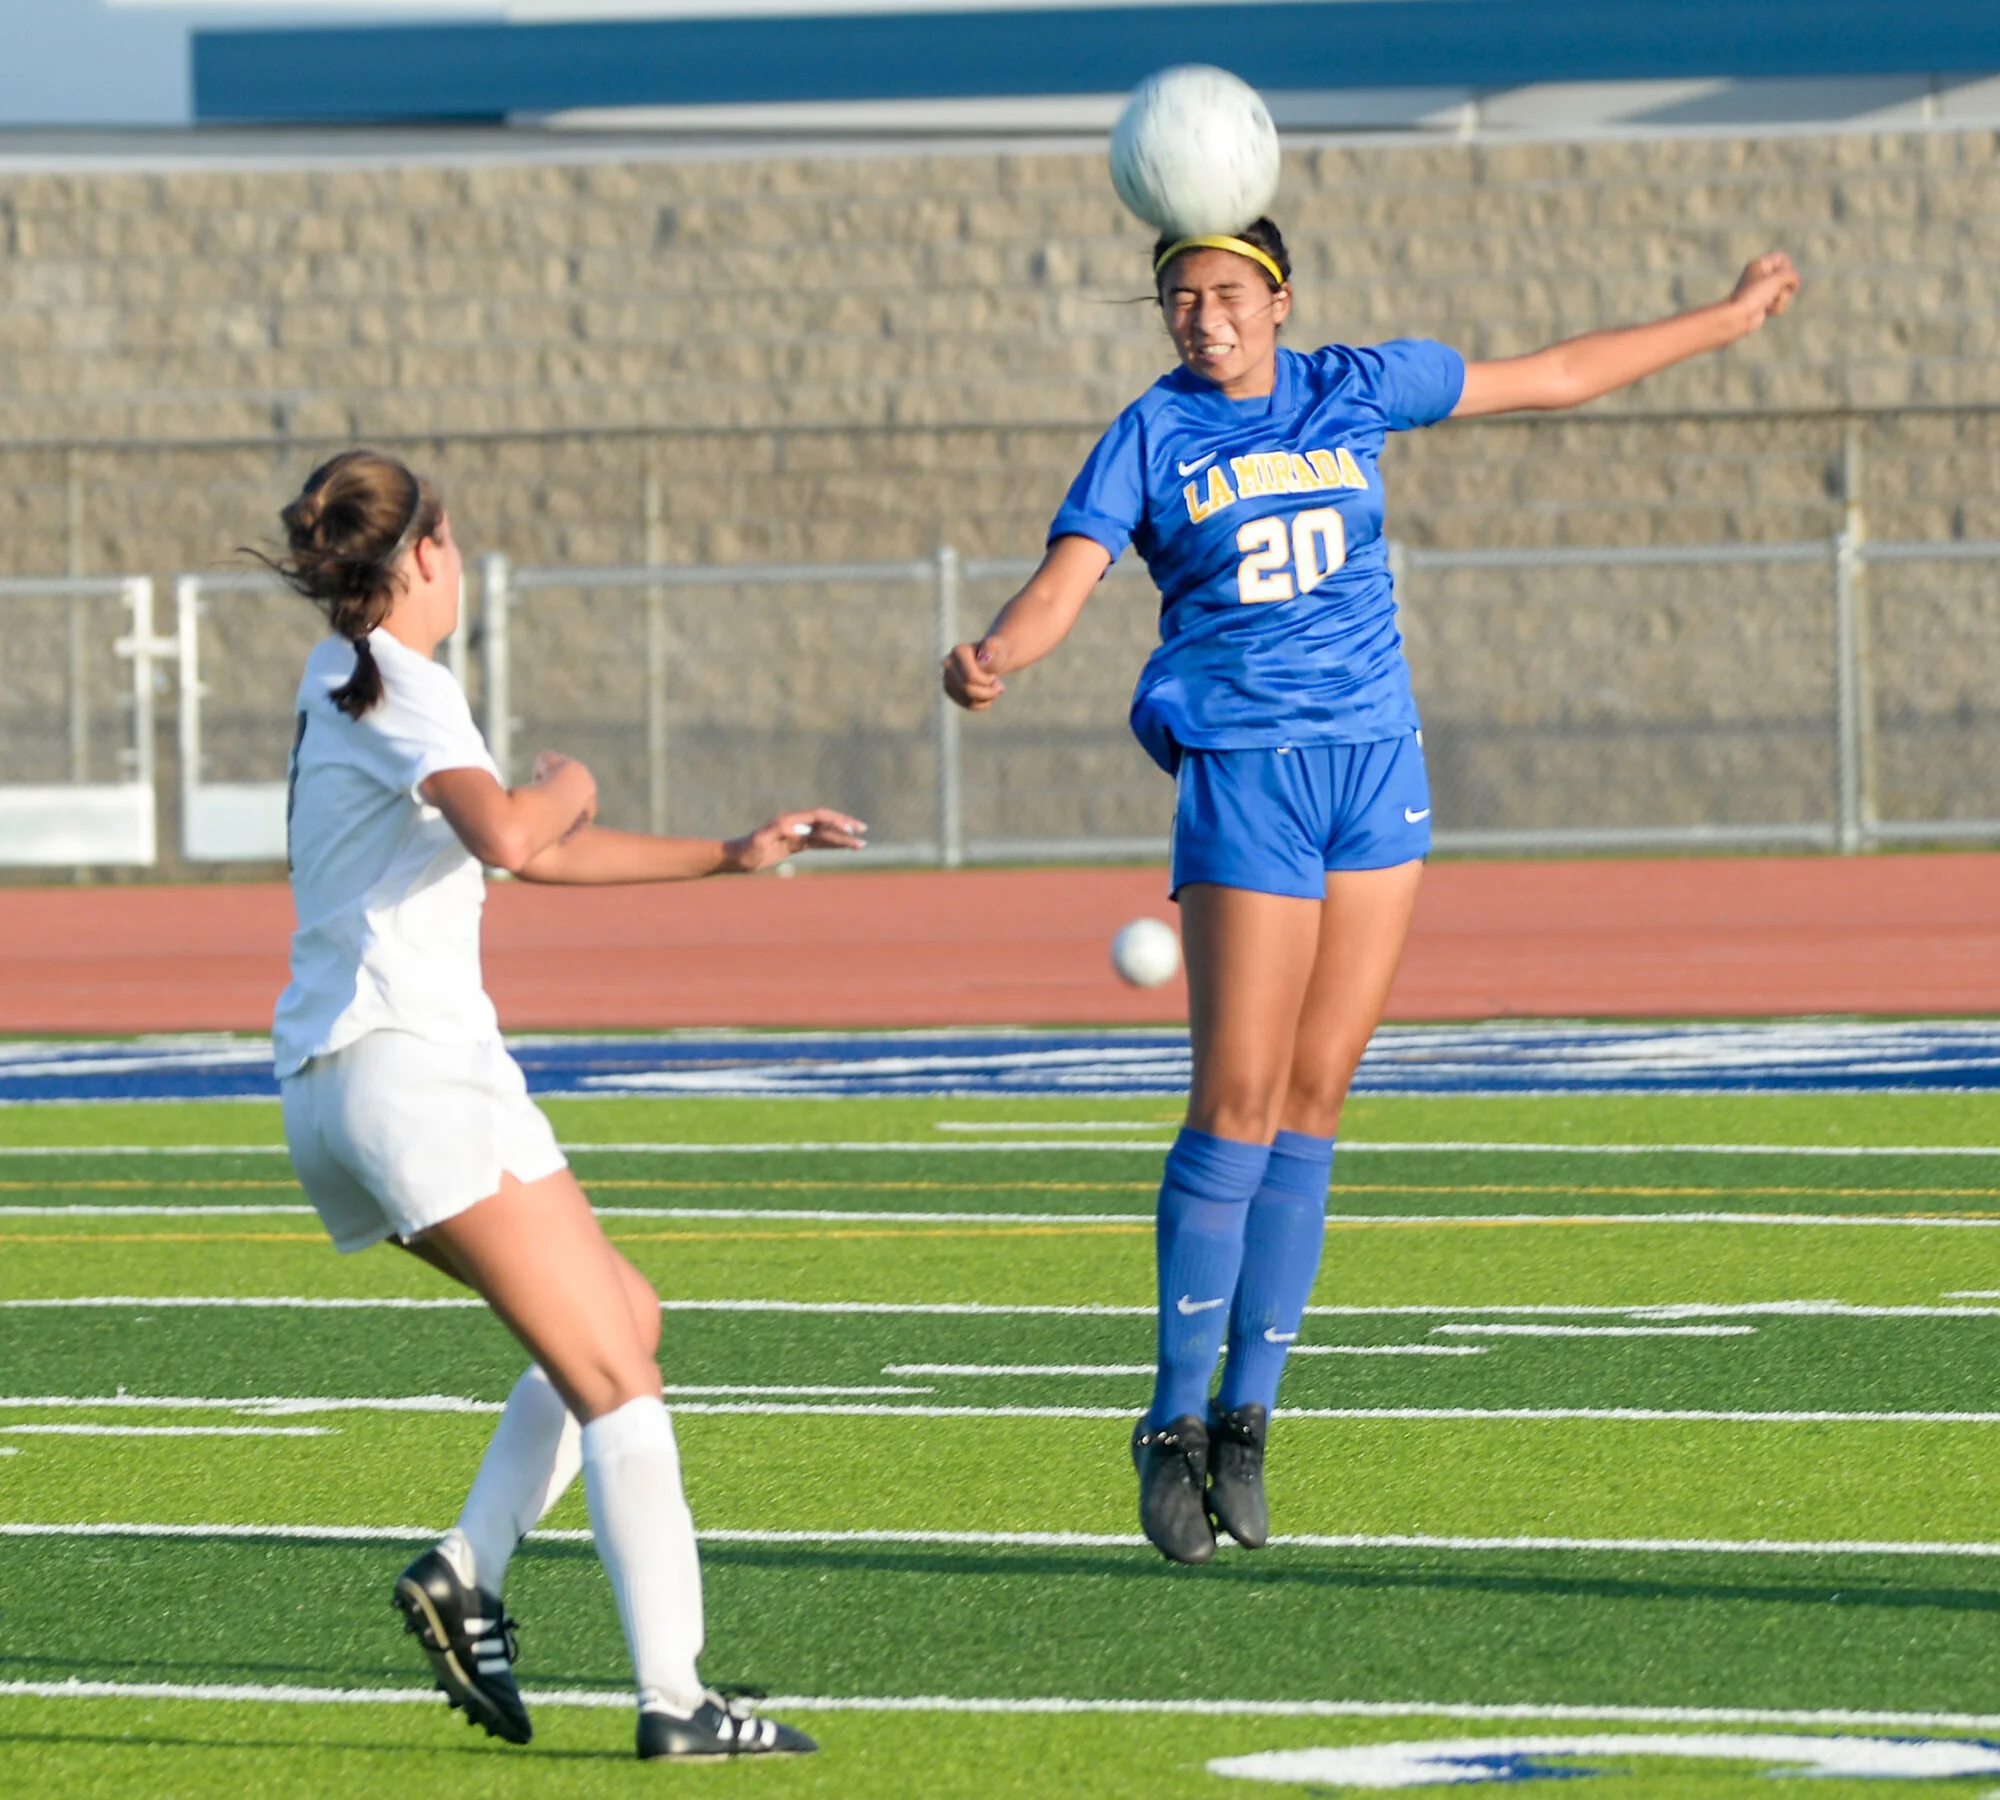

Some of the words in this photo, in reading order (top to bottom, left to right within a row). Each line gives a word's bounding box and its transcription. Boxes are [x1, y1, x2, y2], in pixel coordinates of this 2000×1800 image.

[1183, 465, 1237, 525] LA
[1230, 447, 1369, 500] MIRADA
[1236, 507, 1346, 604] 20
